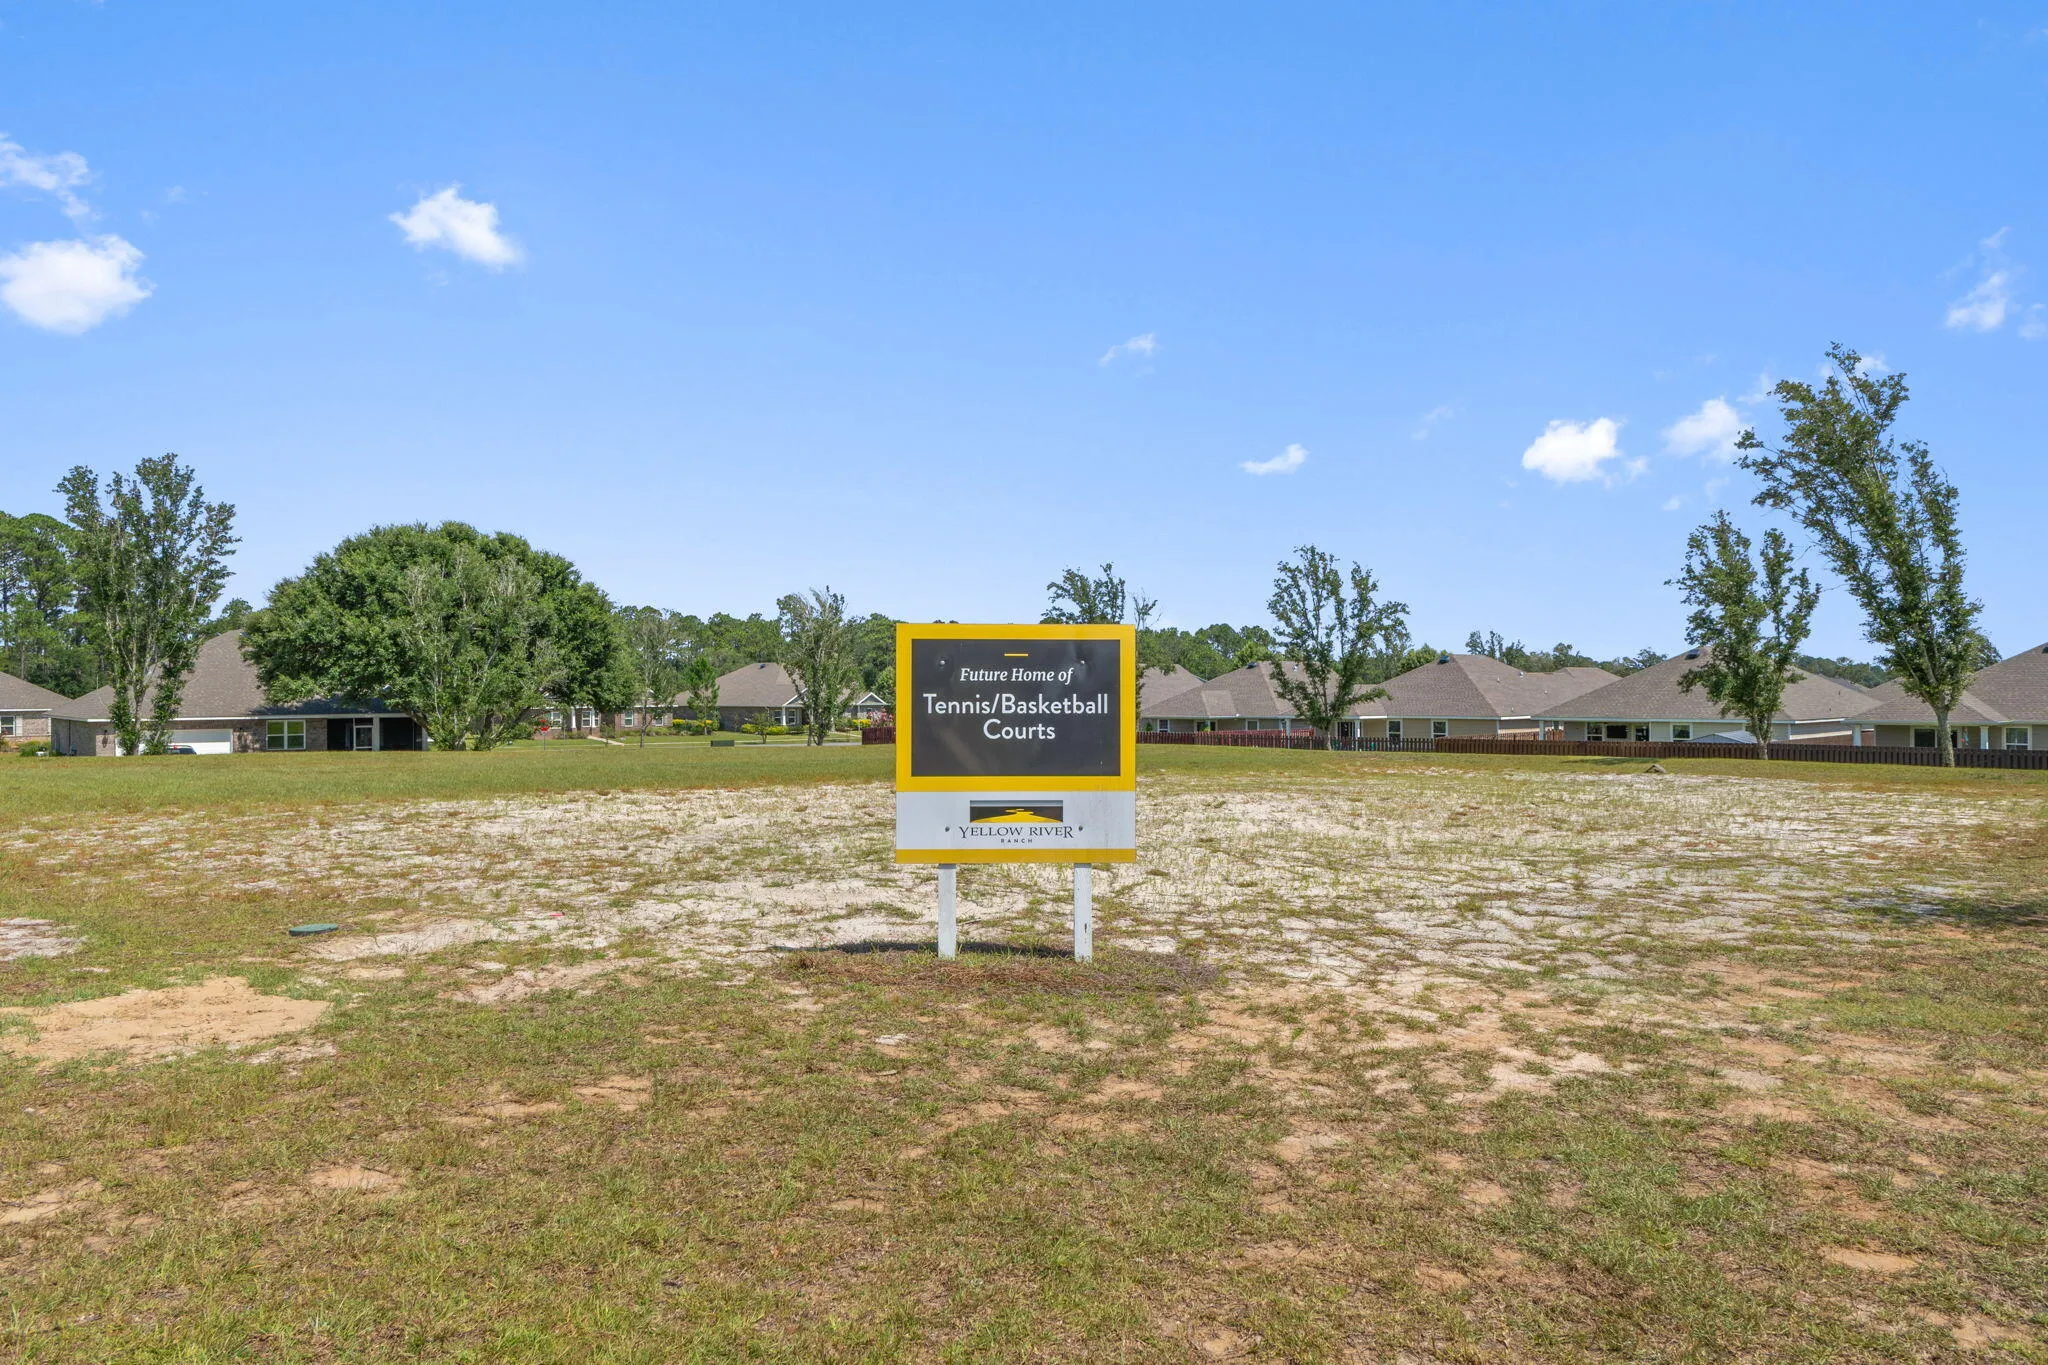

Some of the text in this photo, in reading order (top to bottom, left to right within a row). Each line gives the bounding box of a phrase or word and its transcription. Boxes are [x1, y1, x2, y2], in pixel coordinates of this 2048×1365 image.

[959, 667, 1075, 686] Future Home of
[922, 693, 1109, 715] Tennis/Basketball
[982, 718, 1056, 740] Courts
[958, 826, 1074, 839] YELLOW RIVER
